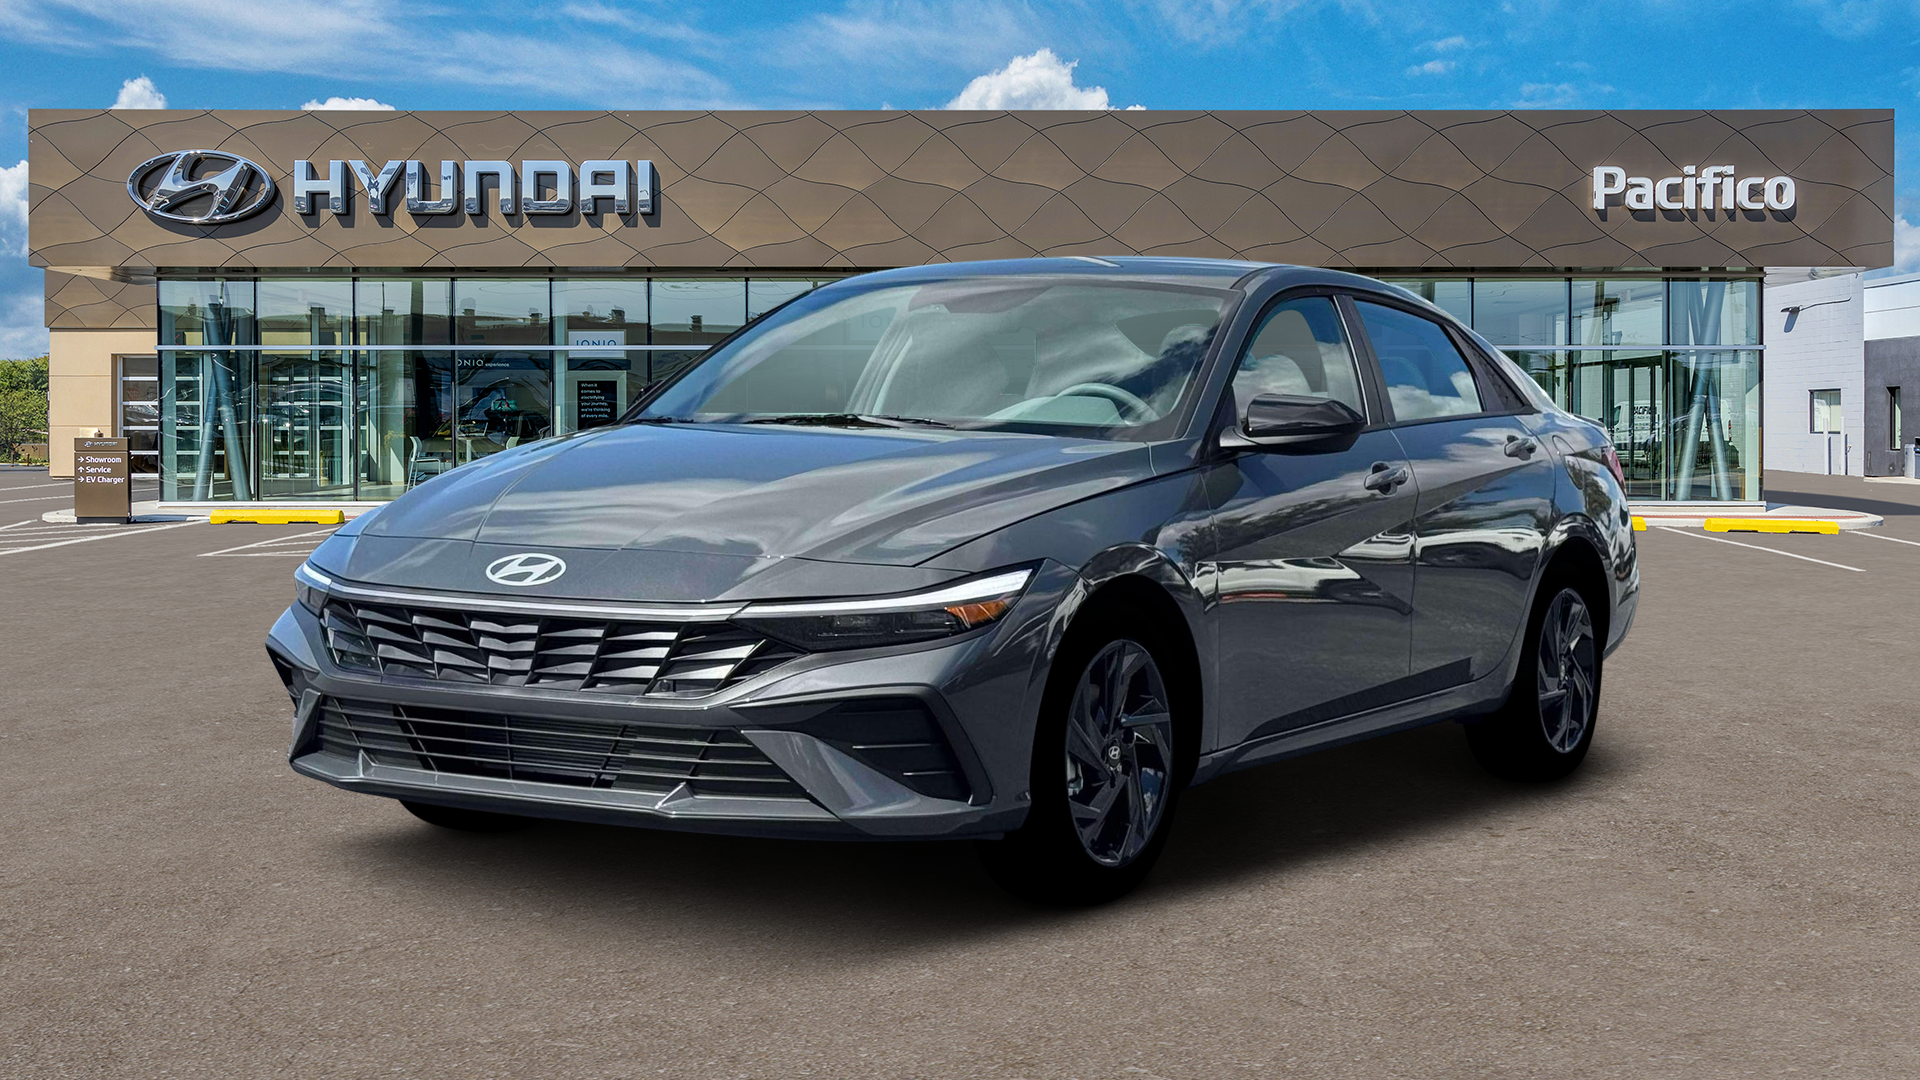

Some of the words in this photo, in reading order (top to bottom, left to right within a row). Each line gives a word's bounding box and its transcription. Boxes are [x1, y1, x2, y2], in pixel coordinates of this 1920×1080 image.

[293, 160, 656, 215] HYUNDAI
[1593, 165, 1796, 211] Pacifico
[97, 476, 125, 484] Charger
